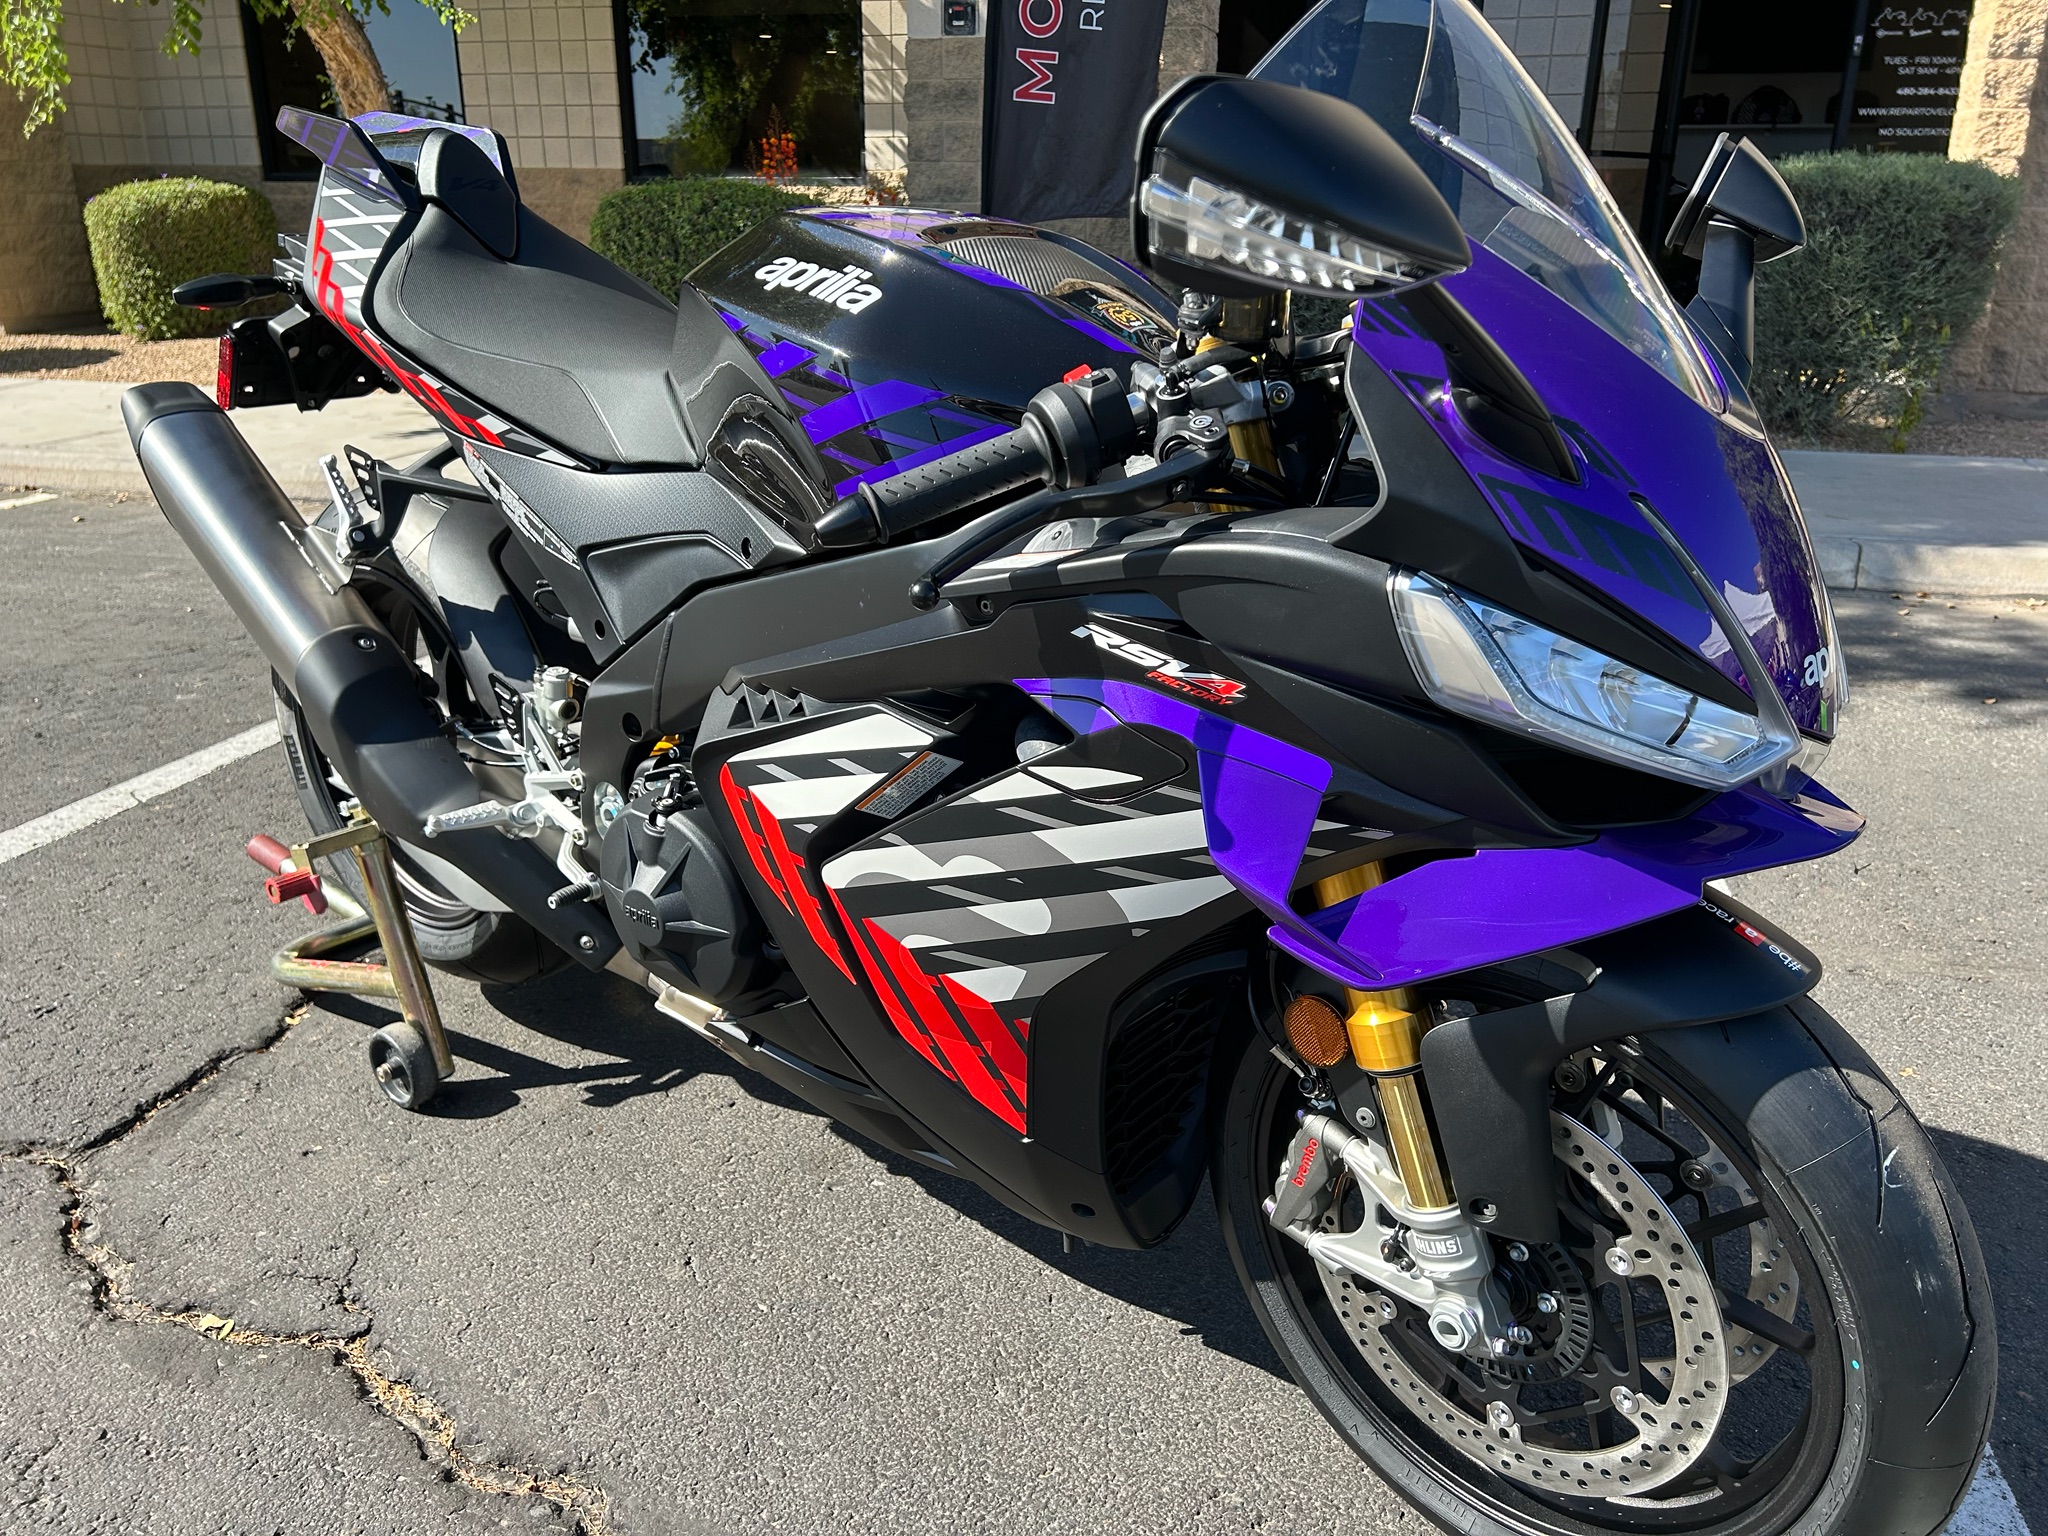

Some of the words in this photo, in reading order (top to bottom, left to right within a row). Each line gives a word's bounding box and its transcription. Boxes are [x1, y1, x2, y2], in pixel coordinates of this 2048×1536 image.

[1884, 56, 1907, 65] TUES
[1914, 56, 1930, 65] FRI
[1897, 67, 1915, 75] SAT
[1878, 128, 1894, 136] NO
[754, 256, 883, 315] aprilia
[1070, 624, 1247, 698] RSV4
[1147, 671, 1235, 705] FACTORY
[625, 904, 660, 931] aprilia
[1768, 944, 1802, 972] #be
[1291, 1137, 1319, 1188] brembo
